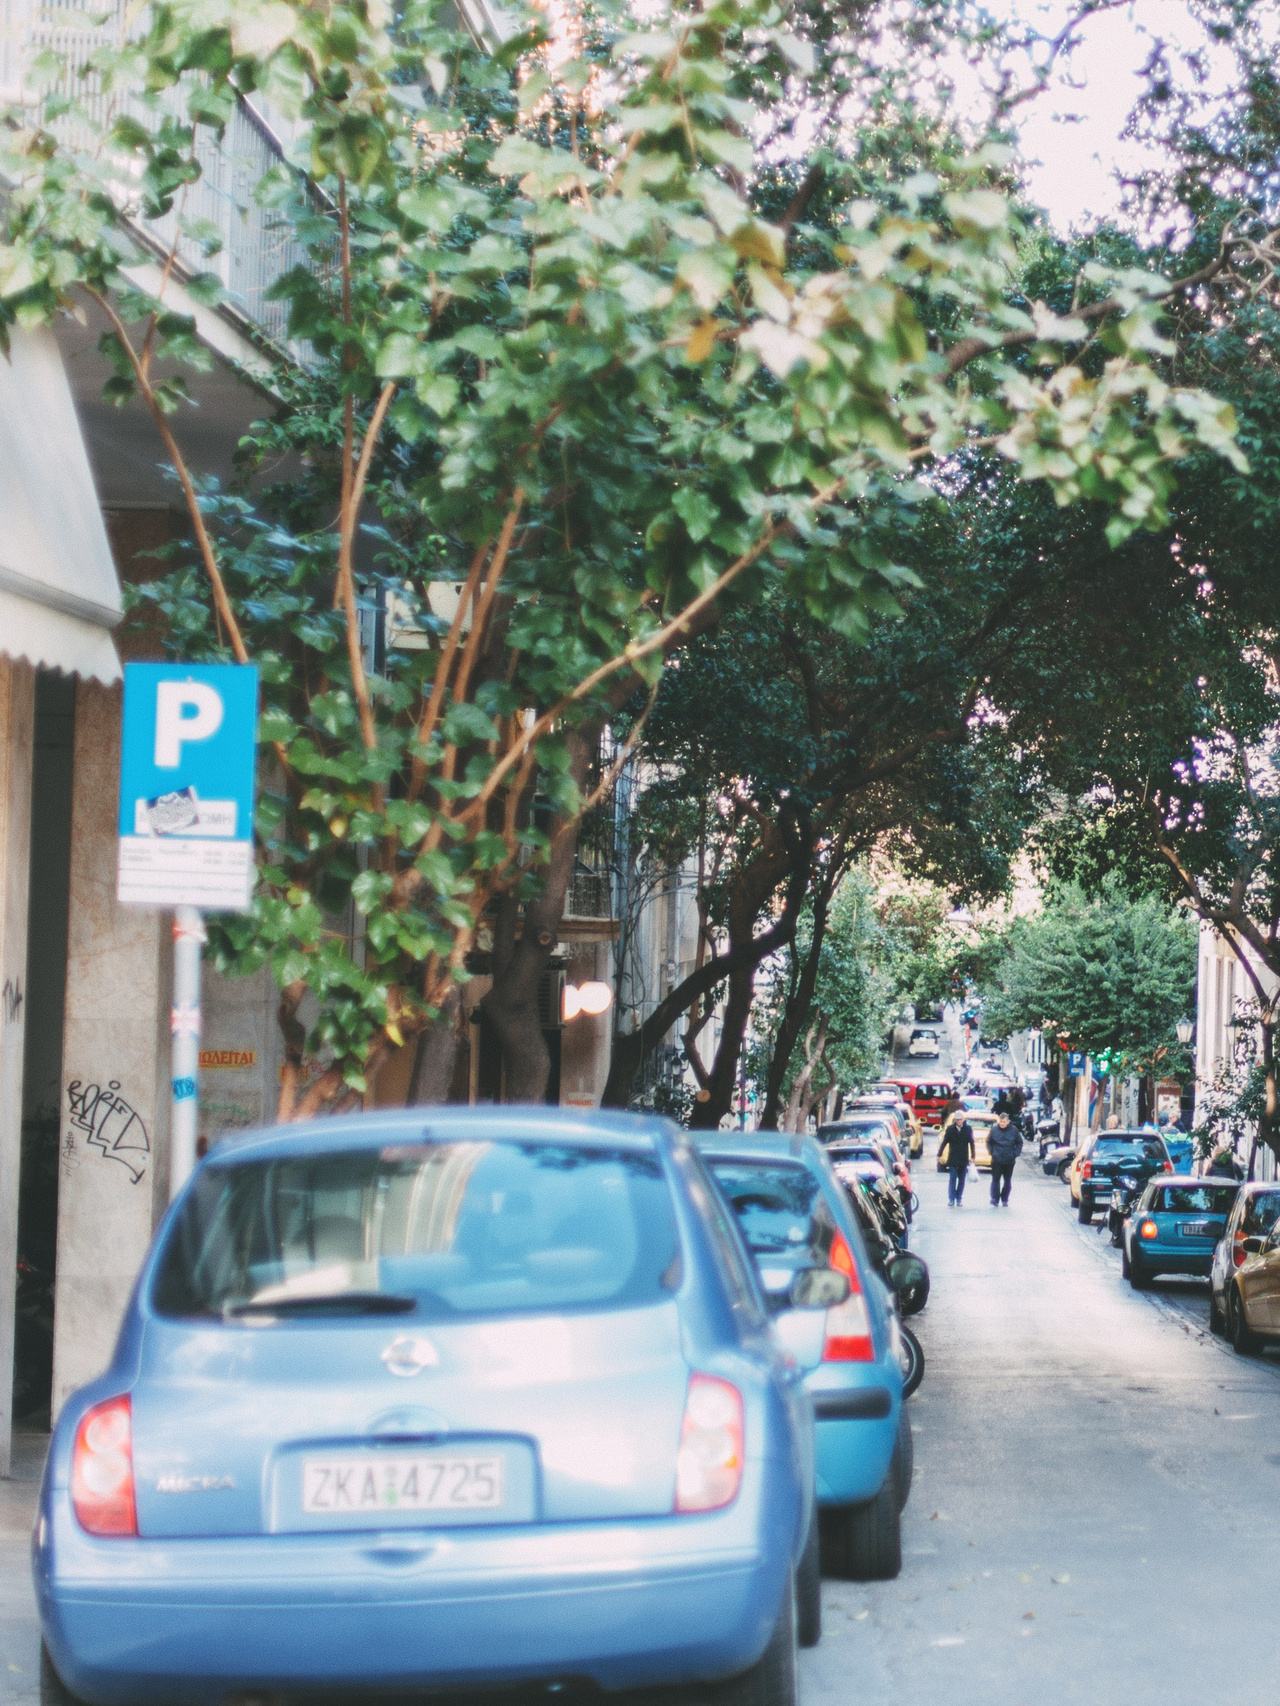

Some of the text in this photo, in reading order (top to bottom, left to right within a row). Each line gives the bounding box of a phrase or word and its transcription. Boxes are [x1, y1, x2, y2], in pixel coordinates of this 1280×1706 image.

[154, 681, 224, 768] P
[1073, 1053, 1082, 1065] P
[156, 1474, 236, 1493] MICRA
[310, 1462, 495, 1508] ZKA 4725
